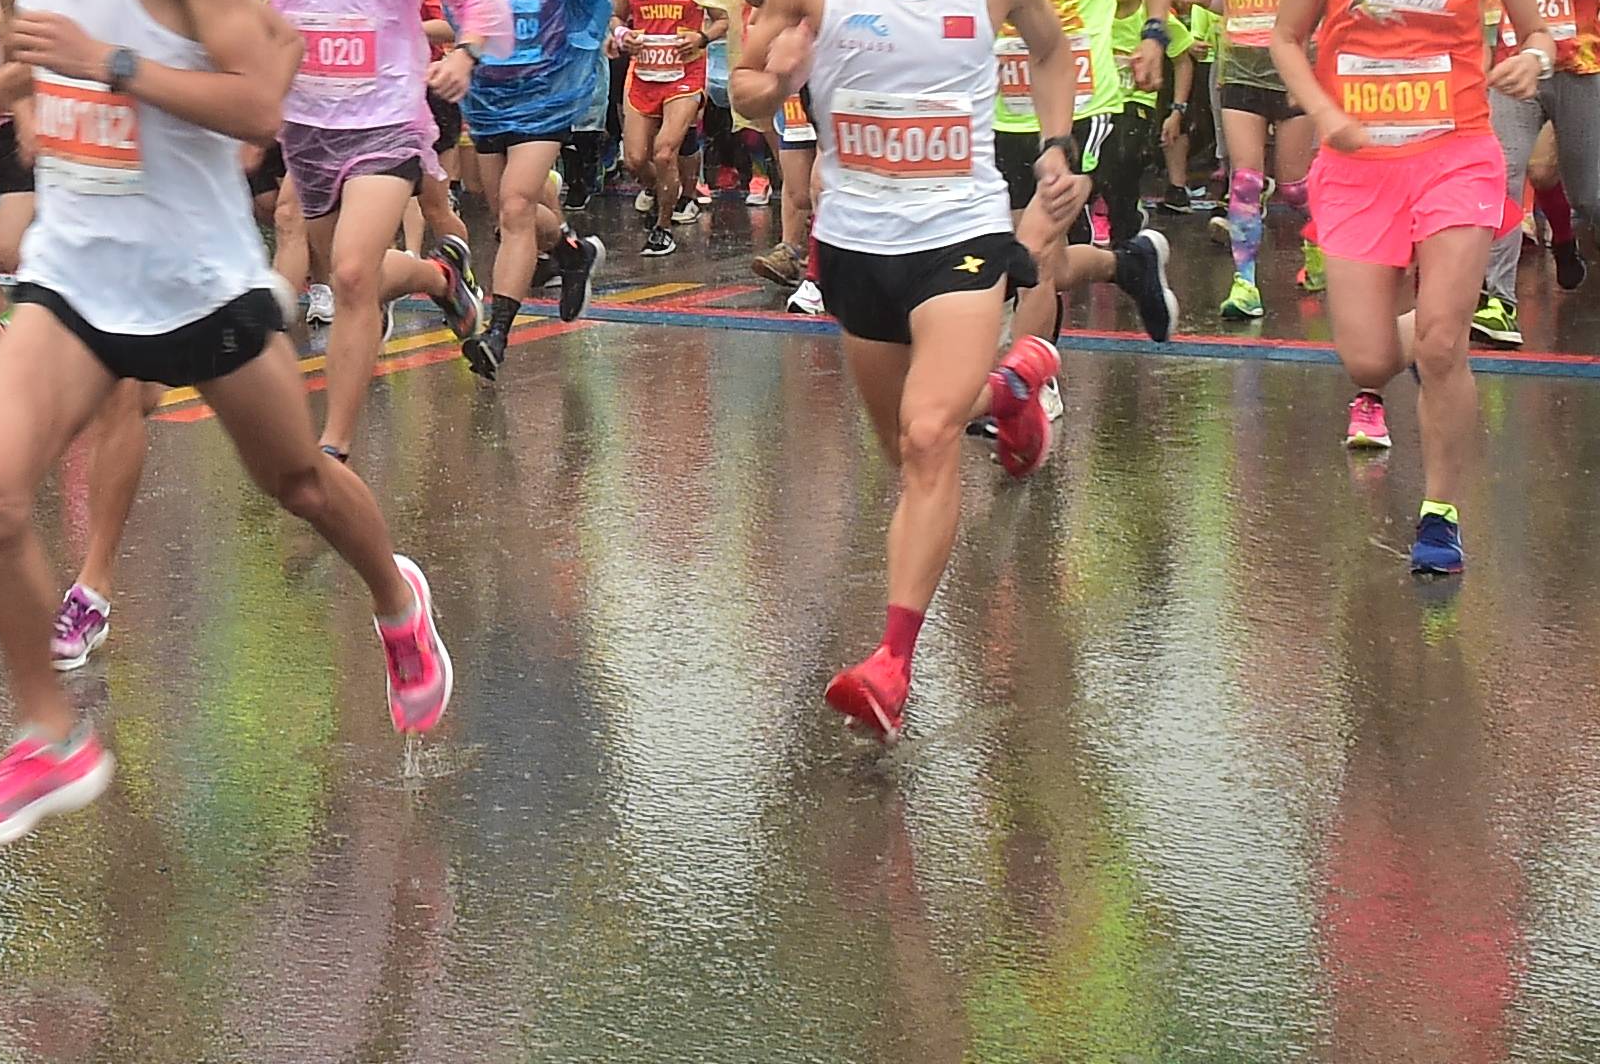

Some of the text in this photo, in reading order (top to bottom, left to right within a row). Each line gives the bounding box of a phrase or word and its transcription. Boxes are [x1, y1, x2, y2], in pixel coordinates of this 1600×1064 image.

[640, 4, 684, 20] CHINA
[639, 48, 684, 65] 09262
[1343, 79, 1448, 114] H06091
[837, 121, 970, 163] H06060
